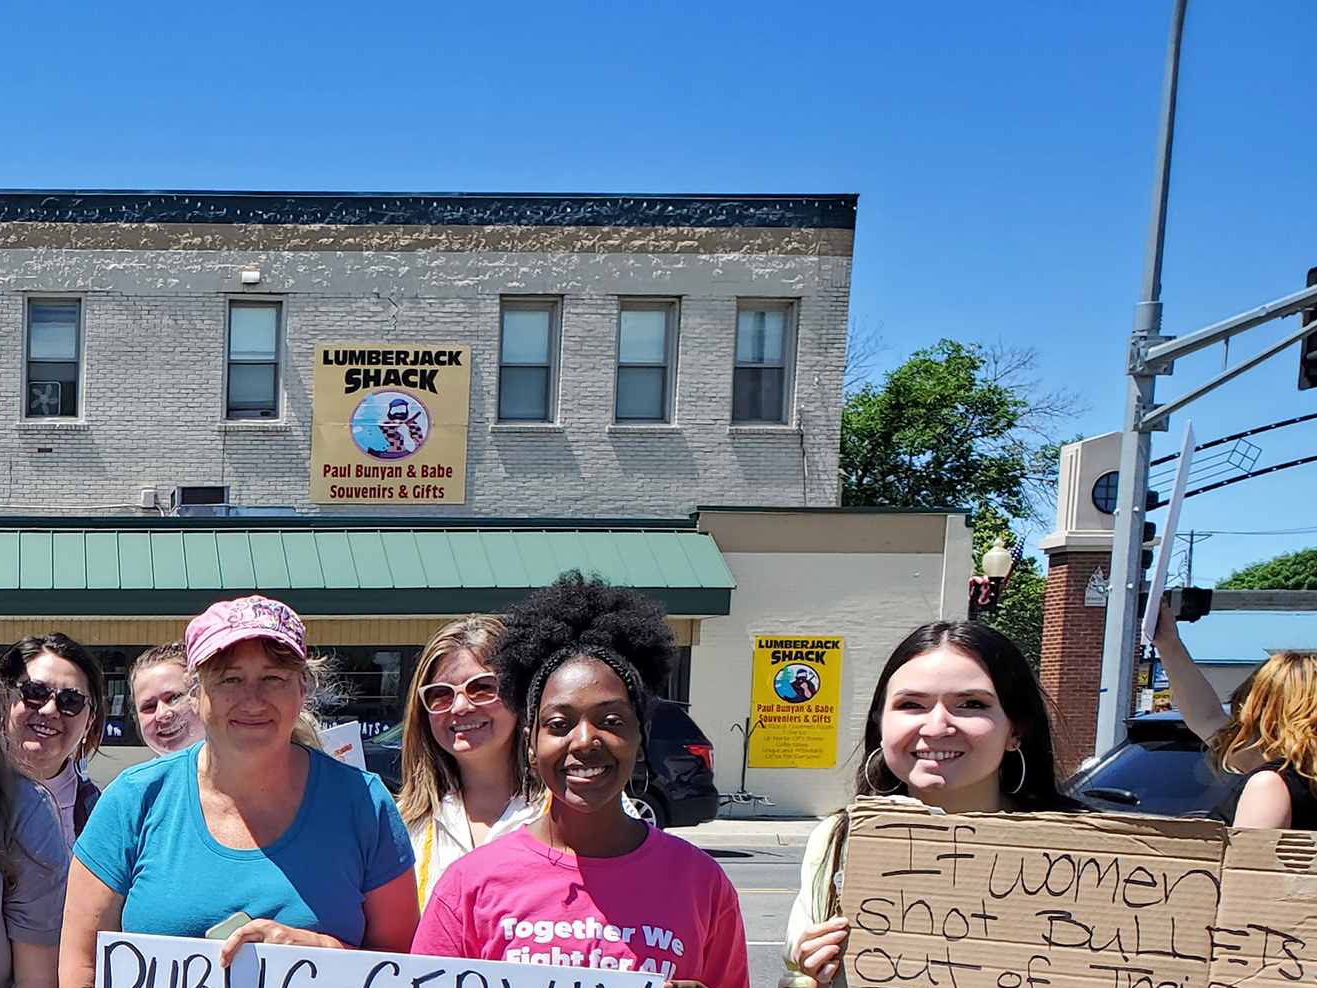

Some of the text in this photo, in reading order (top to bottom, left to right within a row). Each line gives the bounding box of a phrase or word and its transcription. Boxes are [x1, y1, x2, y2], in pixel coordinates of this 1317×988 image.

[322, 349, 463, 366] LUMBERJACK
[344, 368, 439, 395] SHACK
[323, 464, 453, 480] Paul Bunyan & Babe
[330, 484, 445, 499] Souvenirs & Gifts
[758, 639, 841, 650] LUMBERJACK
[771, 650, 826, 666] SHACK
[757, 704, 834, 714] Paul Bunyan & Babe
[803, 715, 811, 723] &
[812, 715, 832, 724] Gifts
[359, 722, 380, 736] ATS
[875, 823, 976, 887] If
[500, 917, 684, 957] Together We
